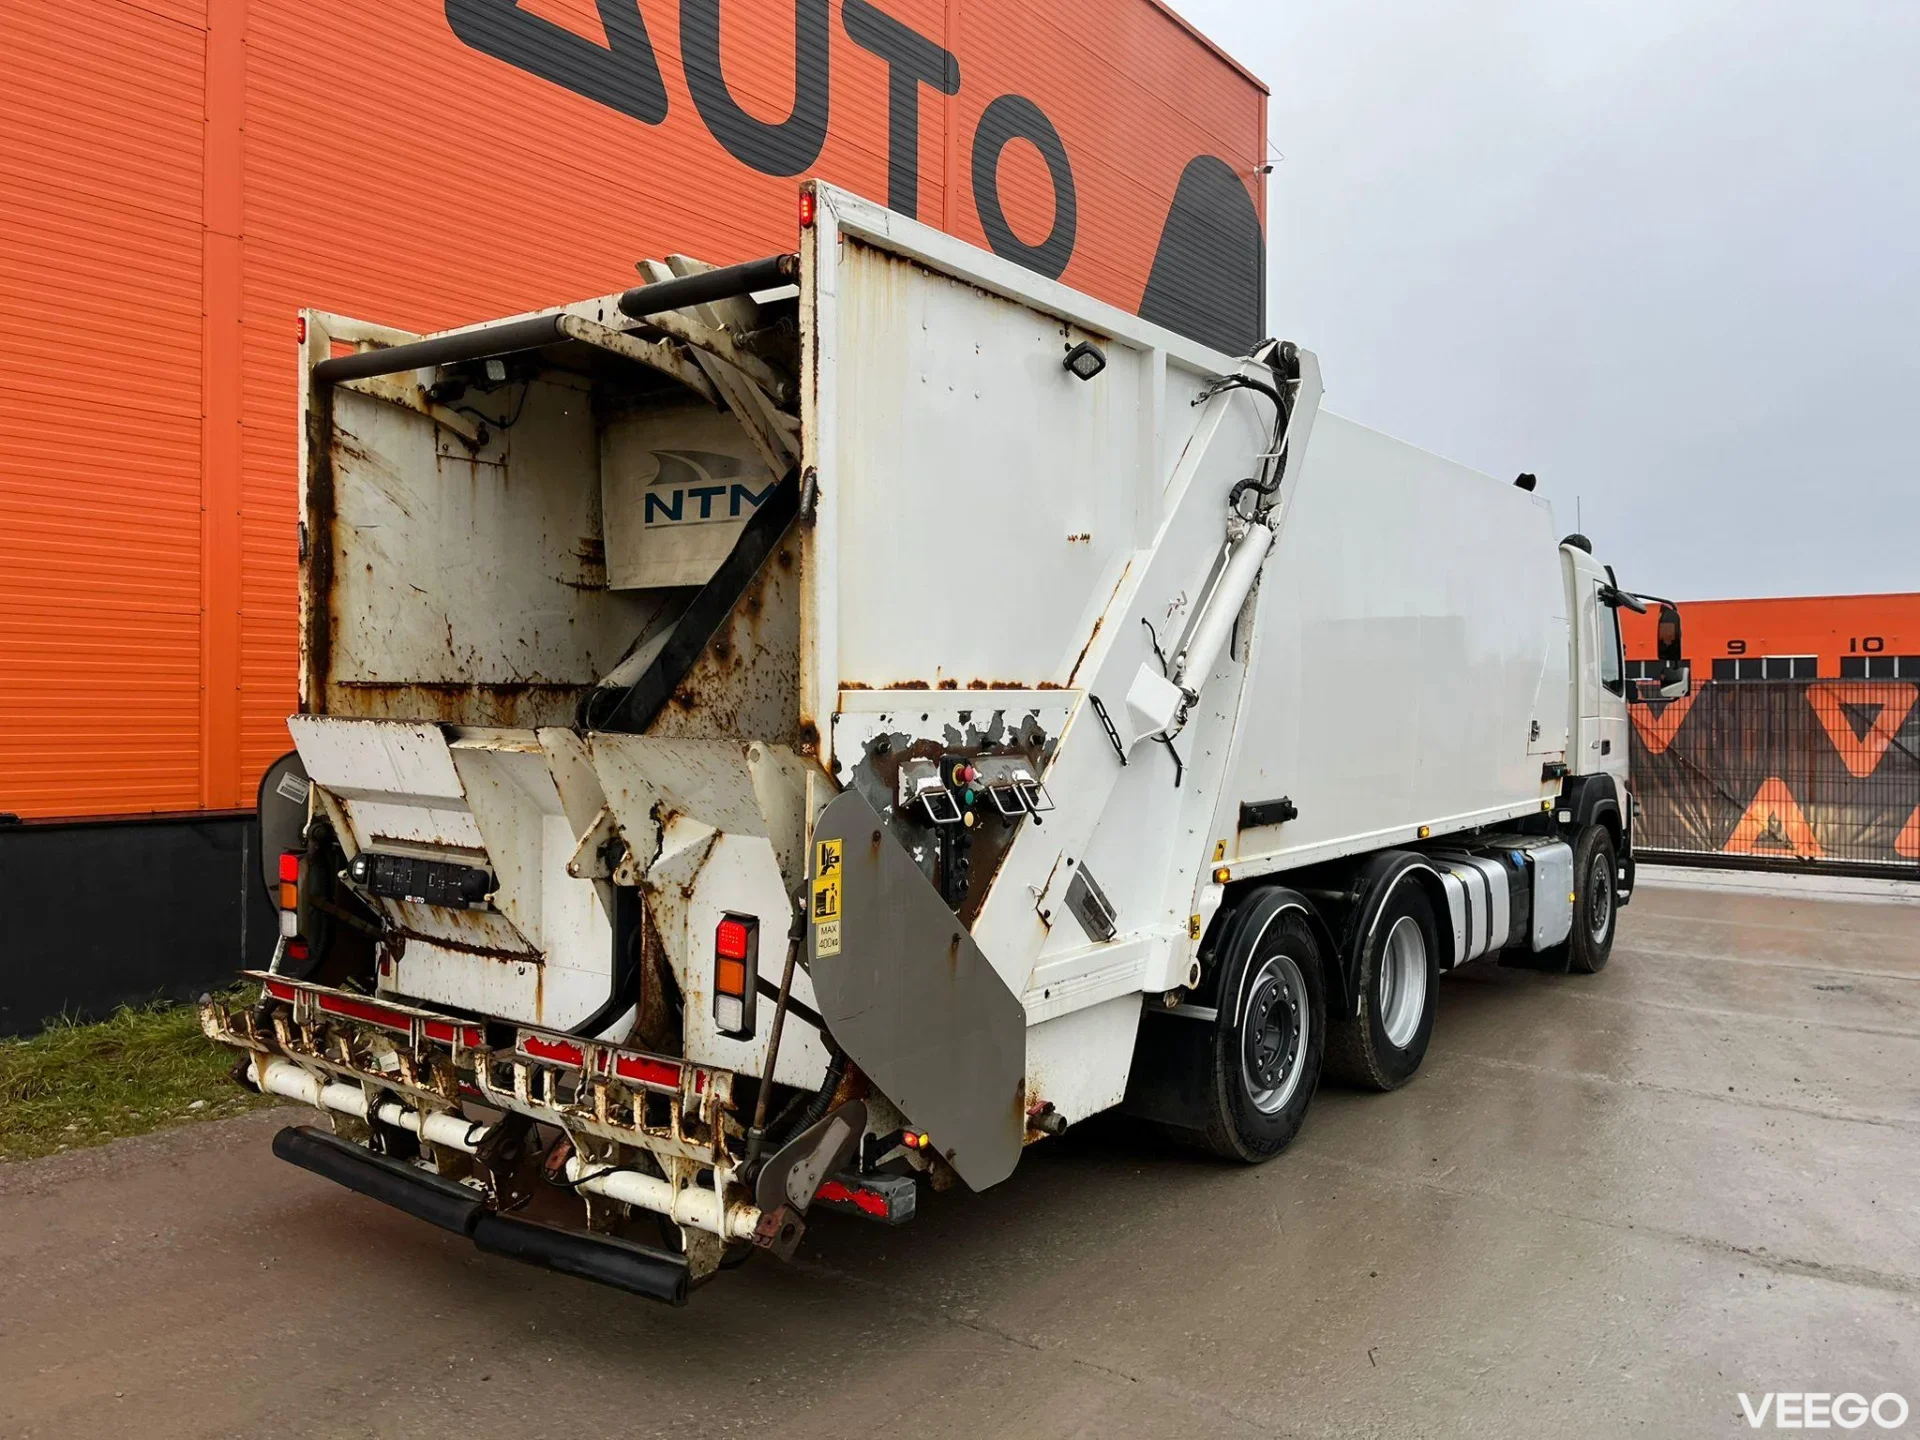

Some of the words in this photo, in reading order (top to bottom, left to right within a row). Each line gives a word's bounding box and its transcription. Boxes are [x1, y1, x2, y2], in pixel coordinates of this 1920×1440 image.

[645, 482, 777, 524] NTM
[1727, 640, 1747, 655] 9
[1850, 637, 1884, 652] 10
[821, 924, 837, 935] MAX
